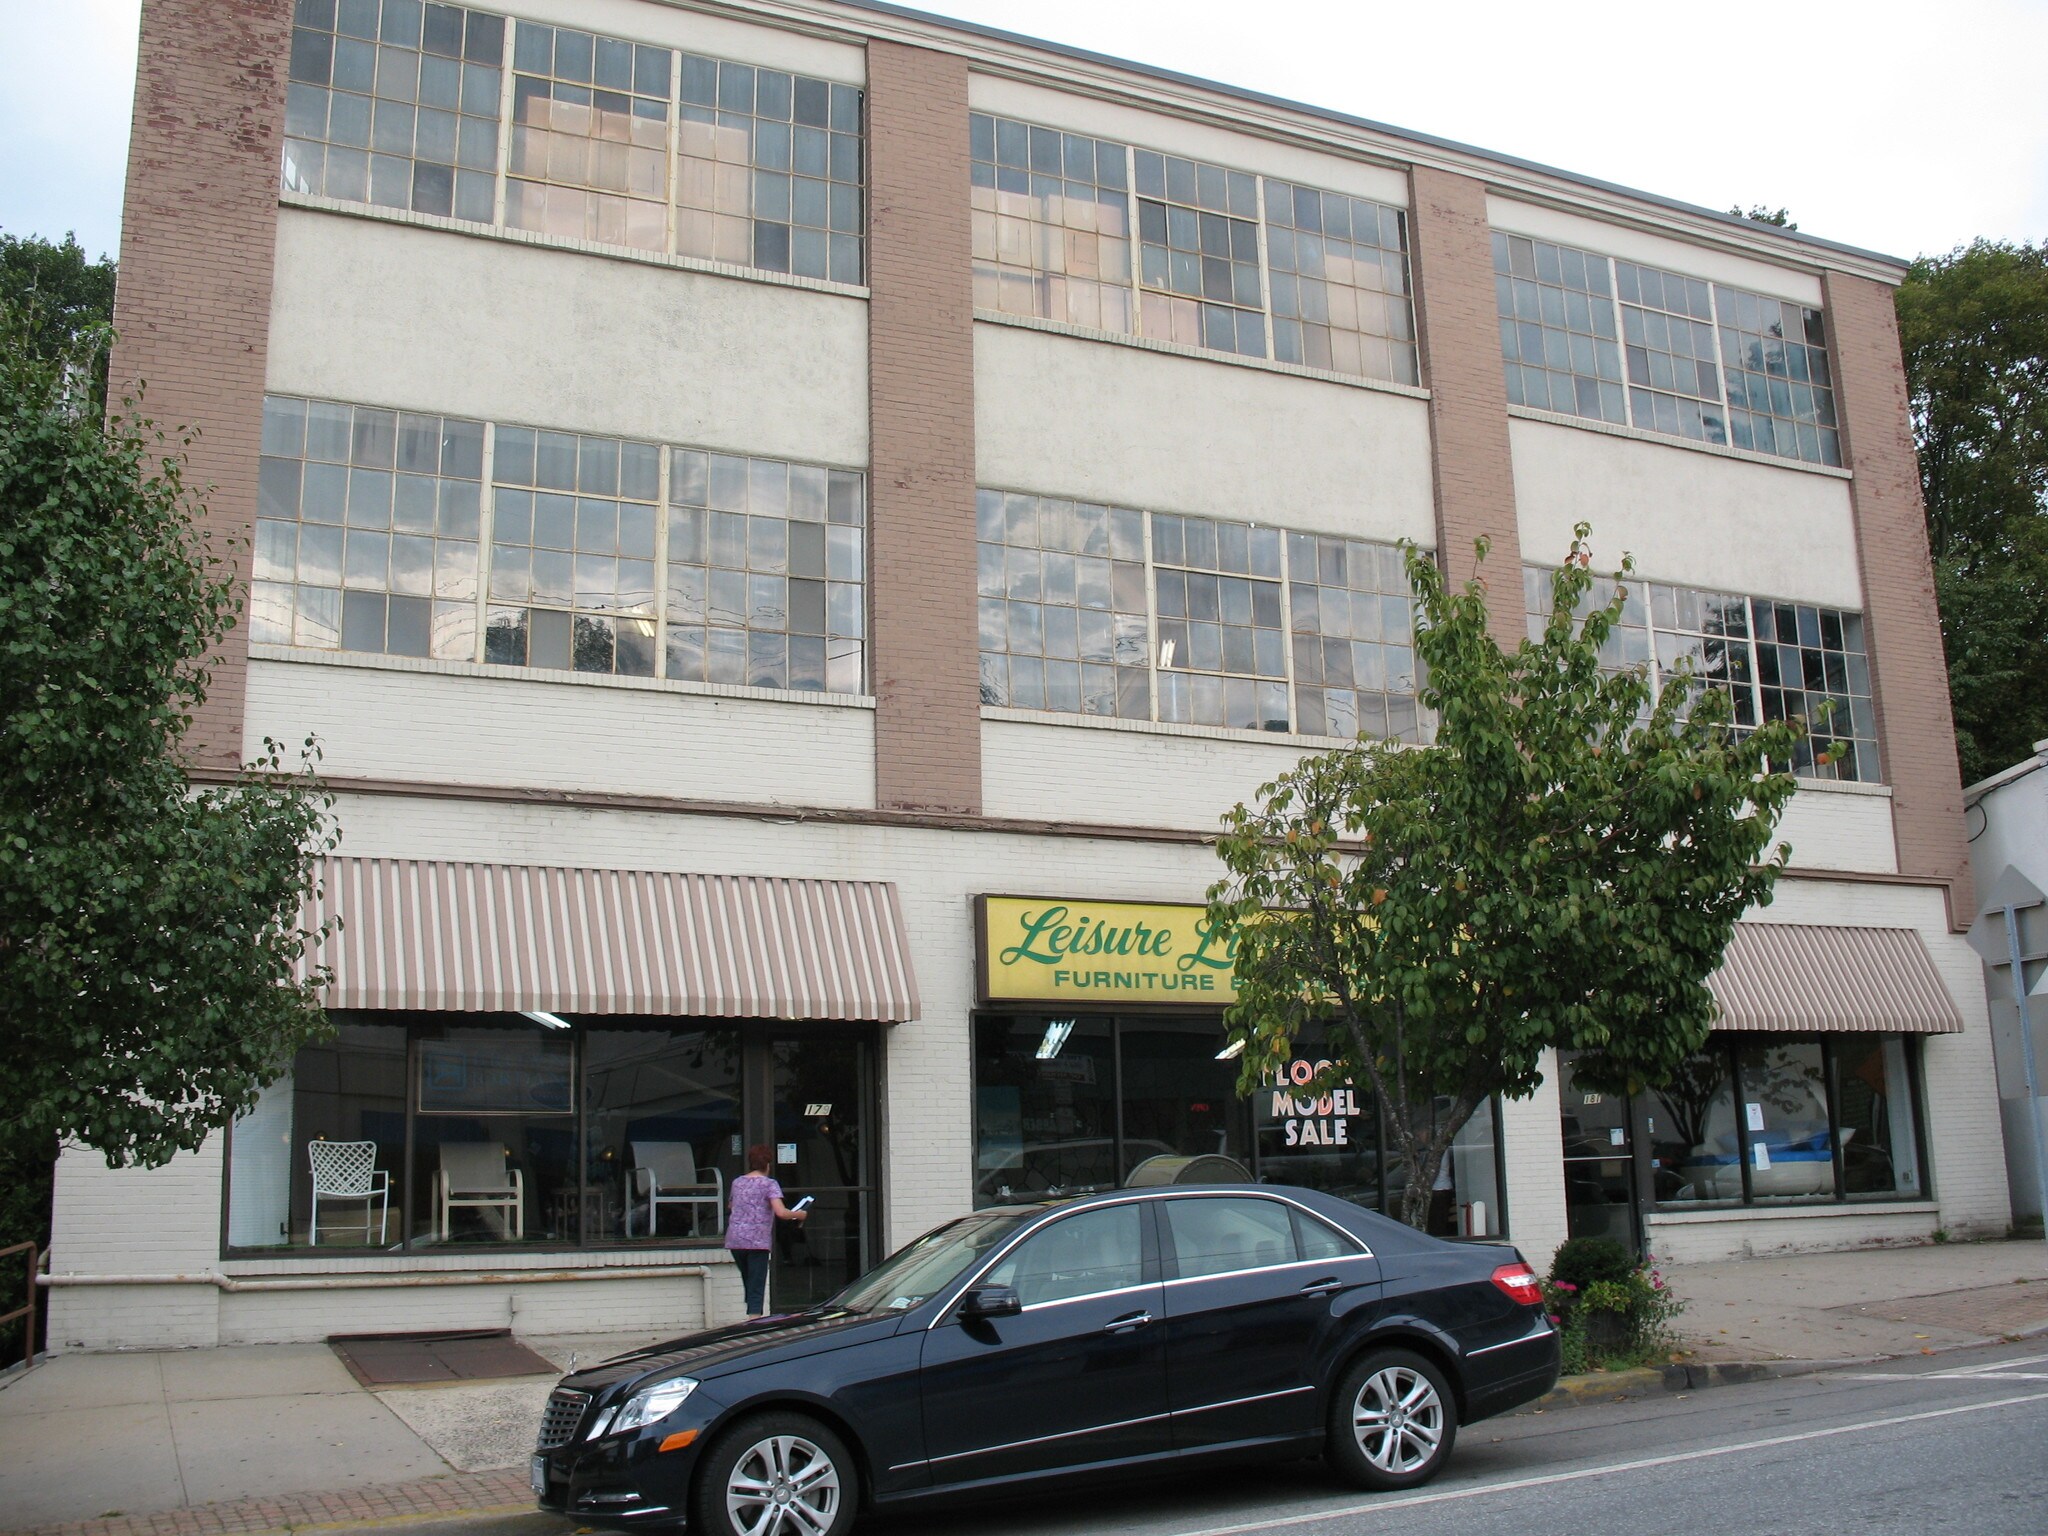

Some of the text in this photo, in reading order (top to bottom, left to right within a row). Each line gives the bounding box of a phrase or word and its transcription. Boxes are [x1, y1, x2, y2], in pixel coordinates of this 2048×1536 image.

[1000, 906, 1172, 966] Leisure
[1054, 970, 1214, 991] FURNITURE
[1271, 1089, 1360, 1116] MODEL
[1285, 1119, 1347, 1146] SALE
